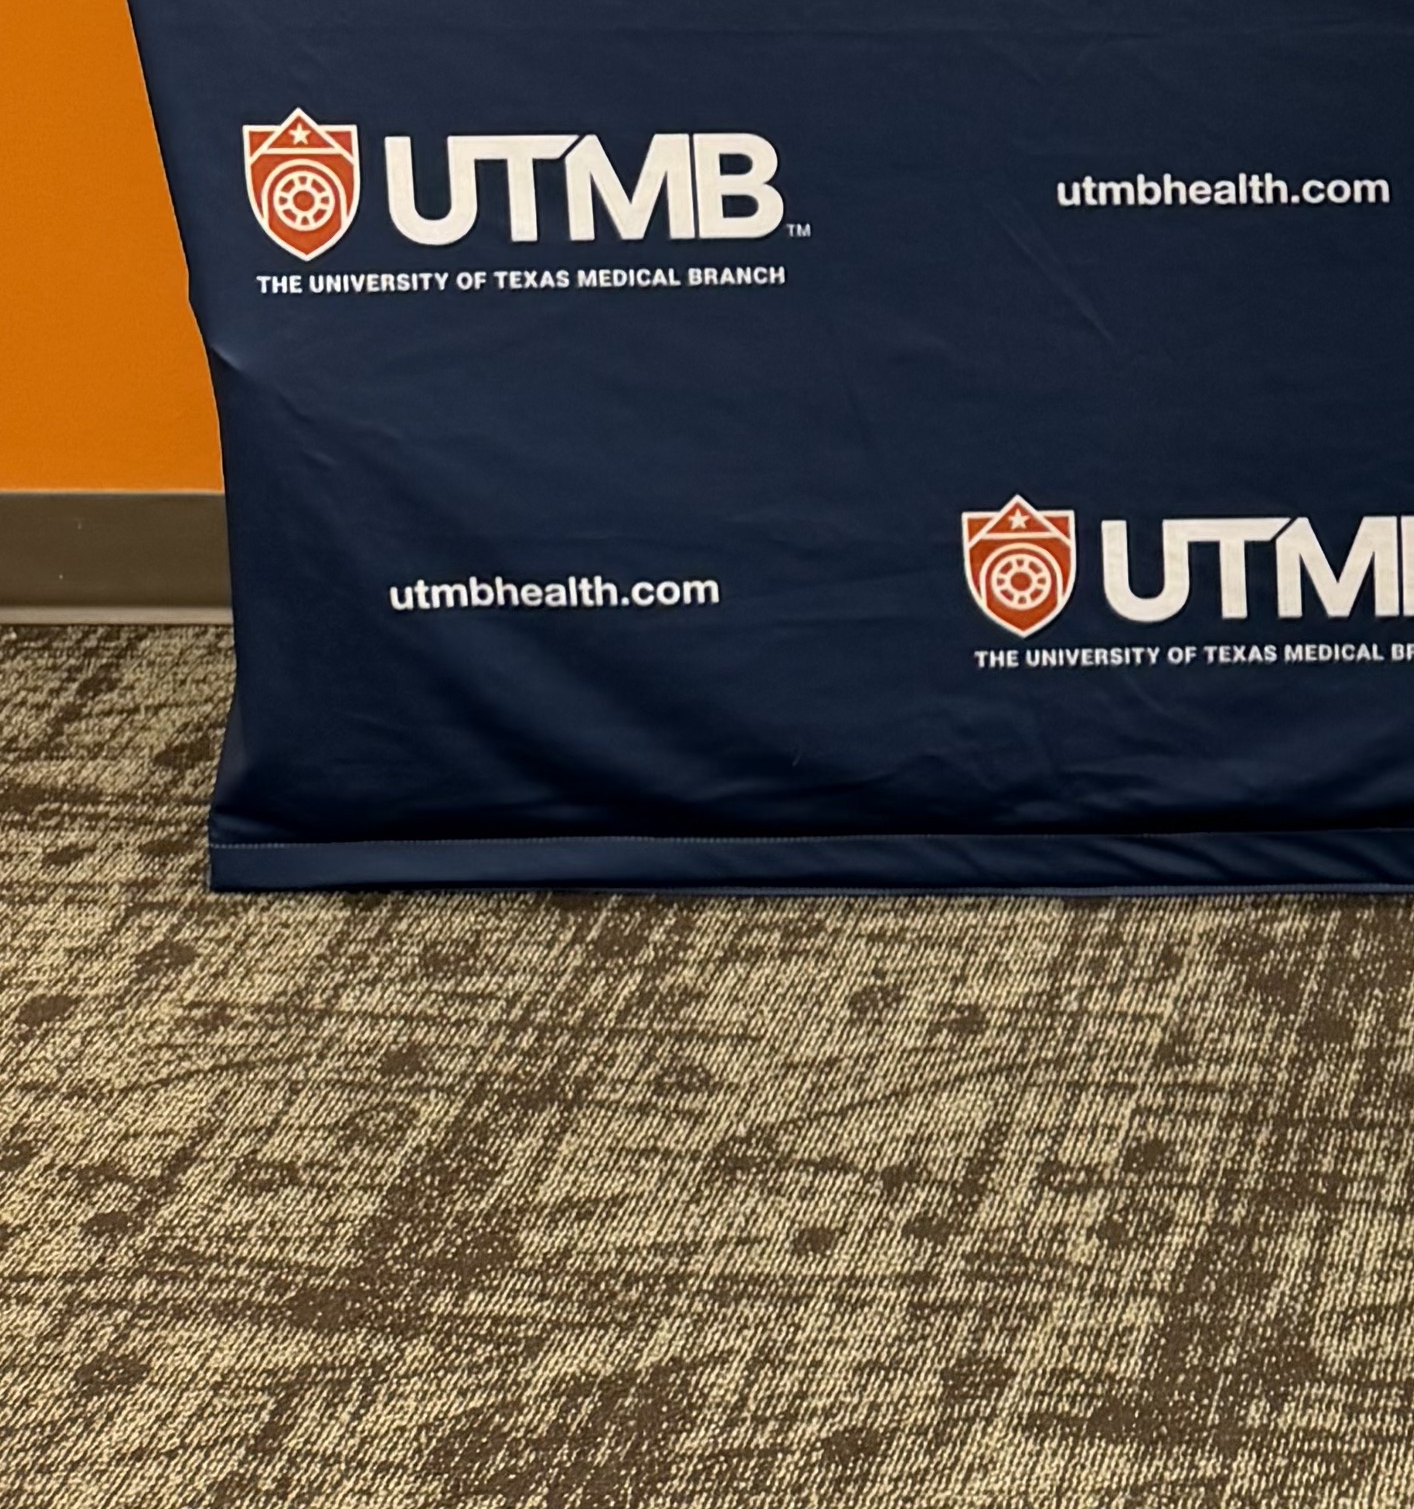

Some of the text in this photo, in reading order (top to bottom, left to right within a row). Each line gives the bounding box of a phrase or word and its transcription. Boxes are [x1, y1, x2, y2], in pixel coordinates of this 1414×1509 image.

[385, 133, 783, 245] UTMB
[1057, 172, 1390, 206] utmbhealth.com
[389, 575, 720, 610] utmbhealth.com
